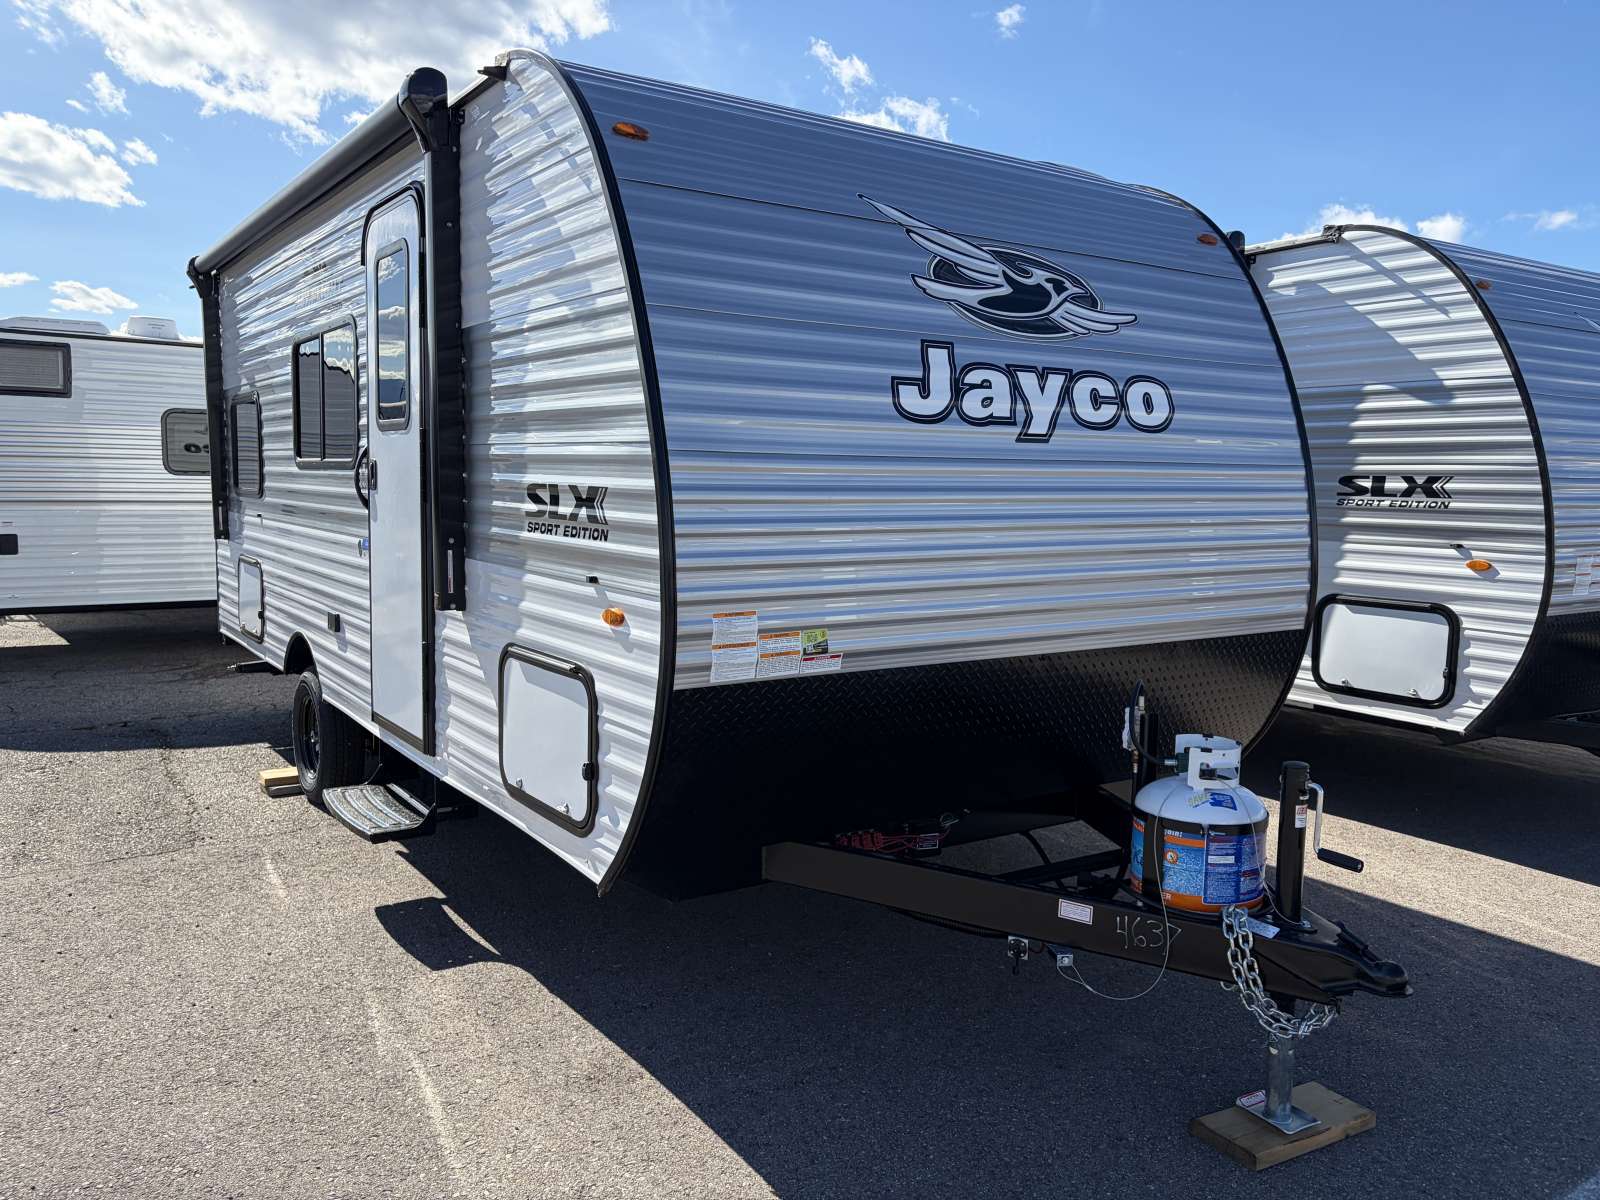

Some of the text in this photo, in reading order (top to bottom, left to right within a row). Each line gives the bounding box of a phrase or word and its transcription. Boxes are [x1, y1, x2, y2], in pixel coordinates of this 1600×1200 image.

[891, 339, 1175, 443] Jayco
[1337, 475, 1454, 498] SLX
[525, 483, 608, 525] SLX
[1336, 498, 1452, 509] SPORT EDITION
[527, 521, 609, 542] SPORT EDITION
[1117, 915, 1181, 955] 4637
